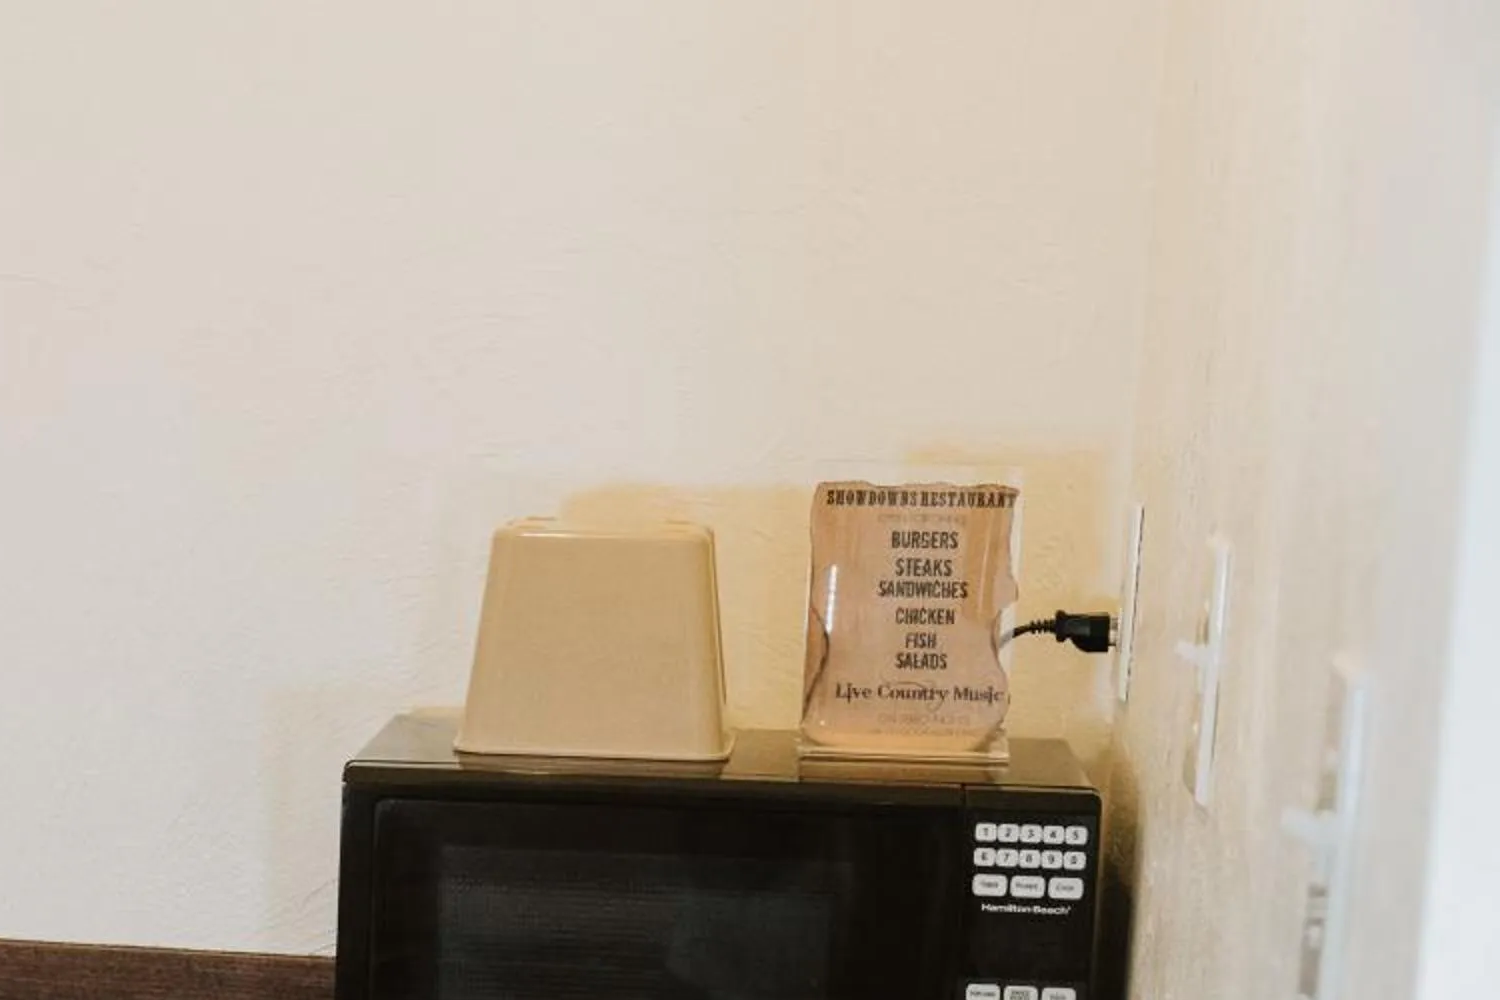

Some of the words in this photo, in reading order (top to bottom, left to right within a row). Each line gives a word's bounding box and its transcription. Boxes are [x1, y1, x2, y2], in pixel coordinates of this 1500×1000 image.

[826, 489, 918, 507] SHOWDOWNS
[919, 490, 1018, 509] RESTAURANT
[891, 530, 959, 549] BURGERS
[895, 558, 953, 577] STEAKS
[877, 580, 968, 599] SANDWICHES
[895, 607, 956, 625] CHICKEN
[905, 632, 937, 649] FISH
[895, 652, 948, 670] SALADS
[835, 682, 873, 703] Live
[877, 684, 949, 702] Country
[953, 685, 1005, 703] Music
